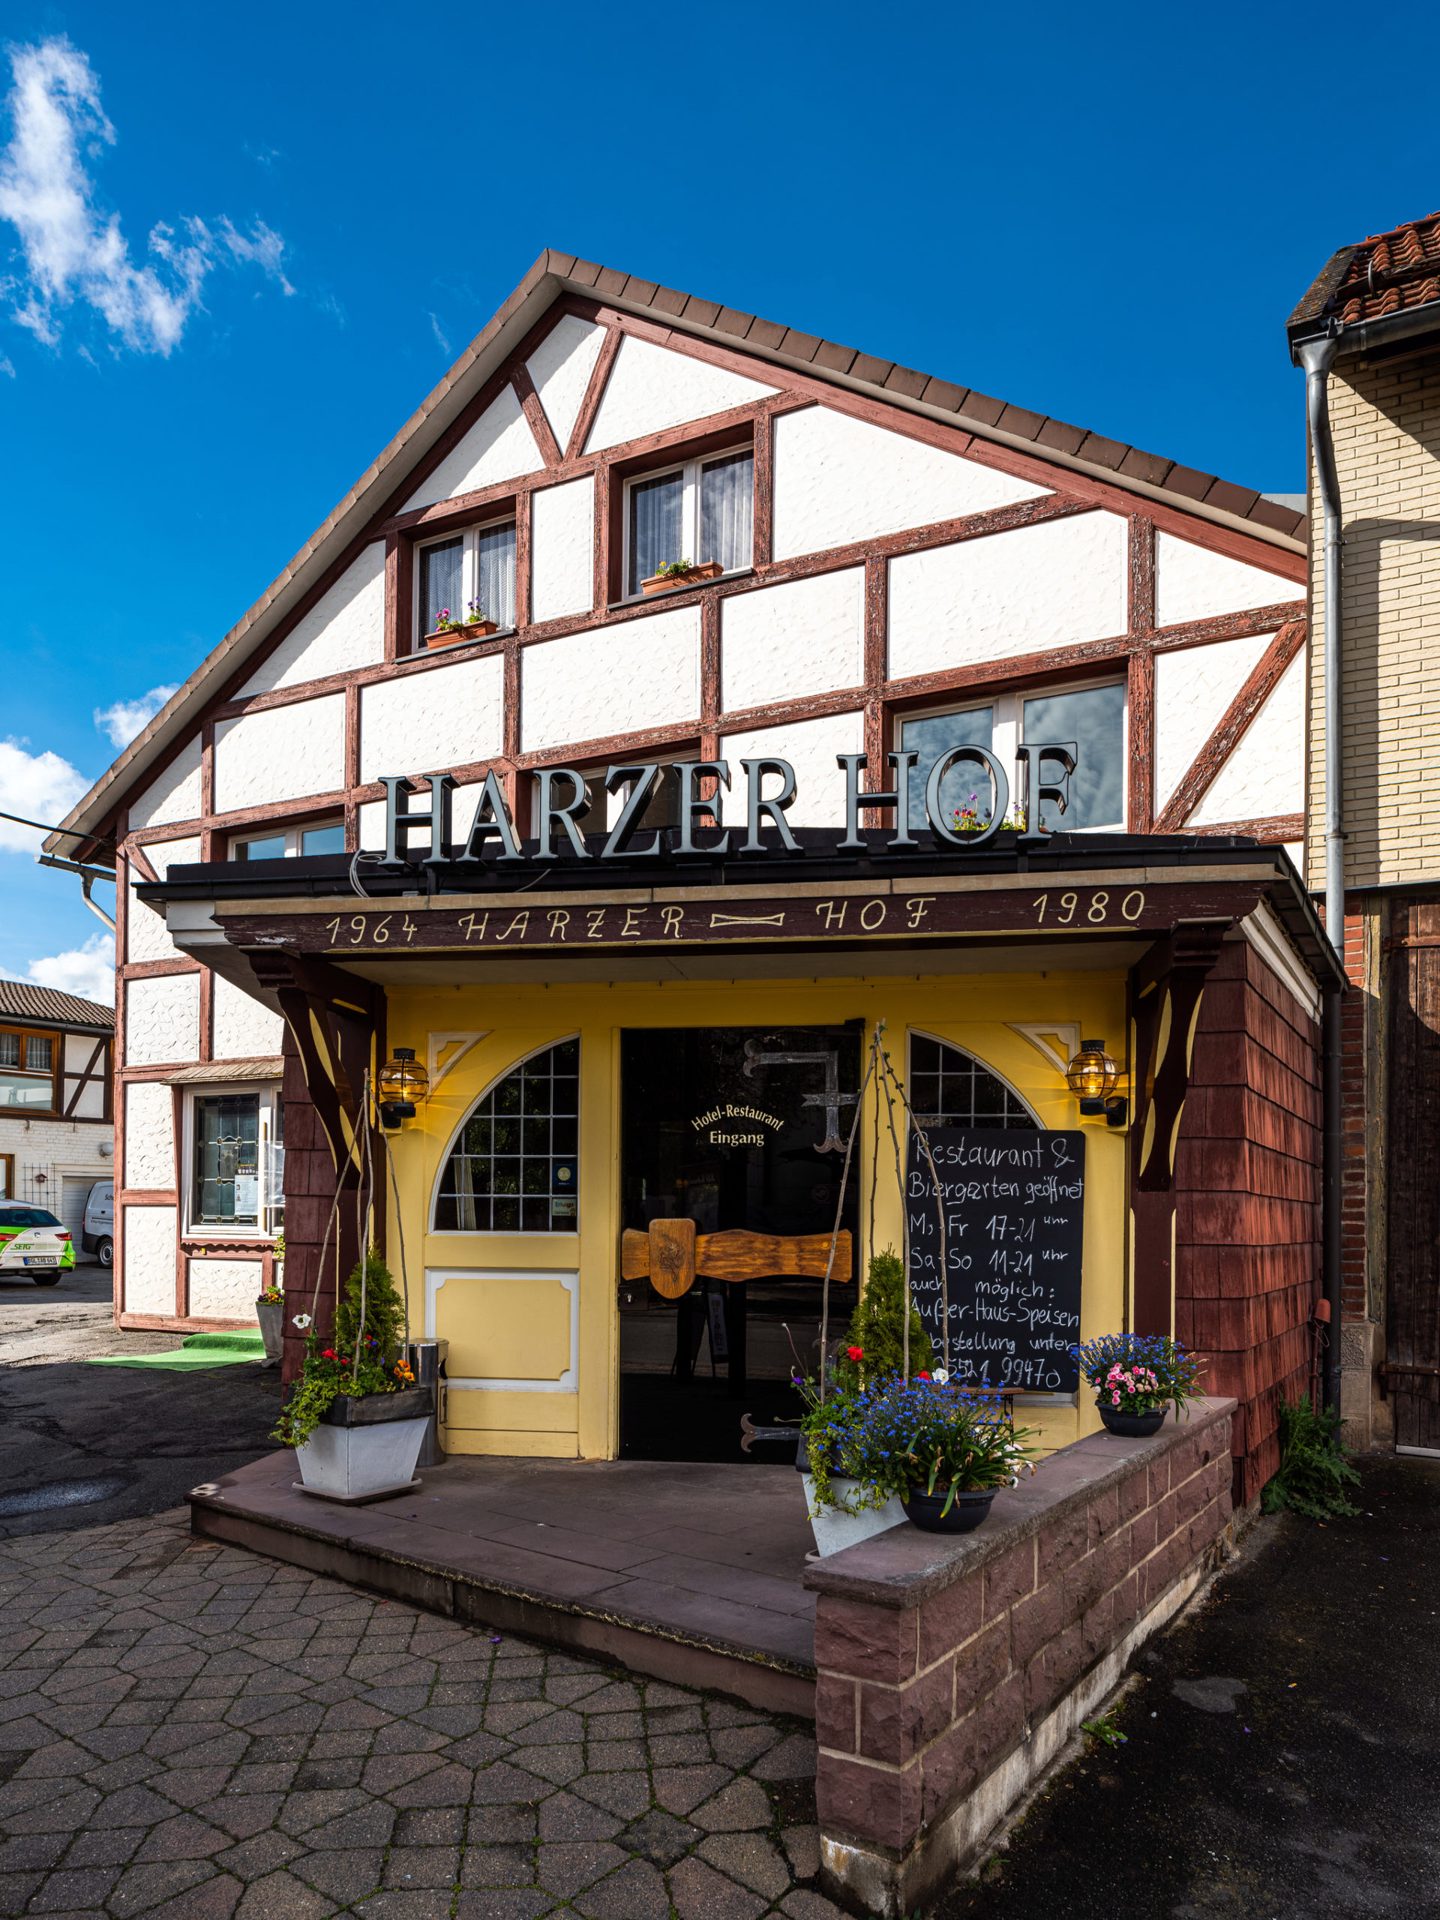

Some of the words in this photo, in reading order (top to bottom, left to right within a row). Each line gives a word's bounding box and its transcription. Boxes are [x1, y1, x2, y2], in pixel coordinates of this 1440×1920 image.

[377, 758, 804, 866] HARZER
[836, 741, 1078, 849] HOF
[325, 913, 418, 945] 1964
[457, 905, 686, 941] HARZER
[815, 896, 937, 930] HOF
[1032, 890, 1145, 923] 1980
[690, 1103, 785, 1132] Hotel-Restaurant
[709, 1130, 765, 1147] Eingang
[912, 1130, 1044, 1168] Restaurant
[1050, 1137, 1076, 1169] &
[908, 1171, 1020, 1206] Biergarten
[1024, 1175, 1085, 1205] geöffnet
[985, 1214, 1036, 1242] 17-21
[988, 1249, 1033, 1277] 11-21
[1029, 1332, 1079, 1351] unter
[1001, 1356, 1062, 1389] 99470
